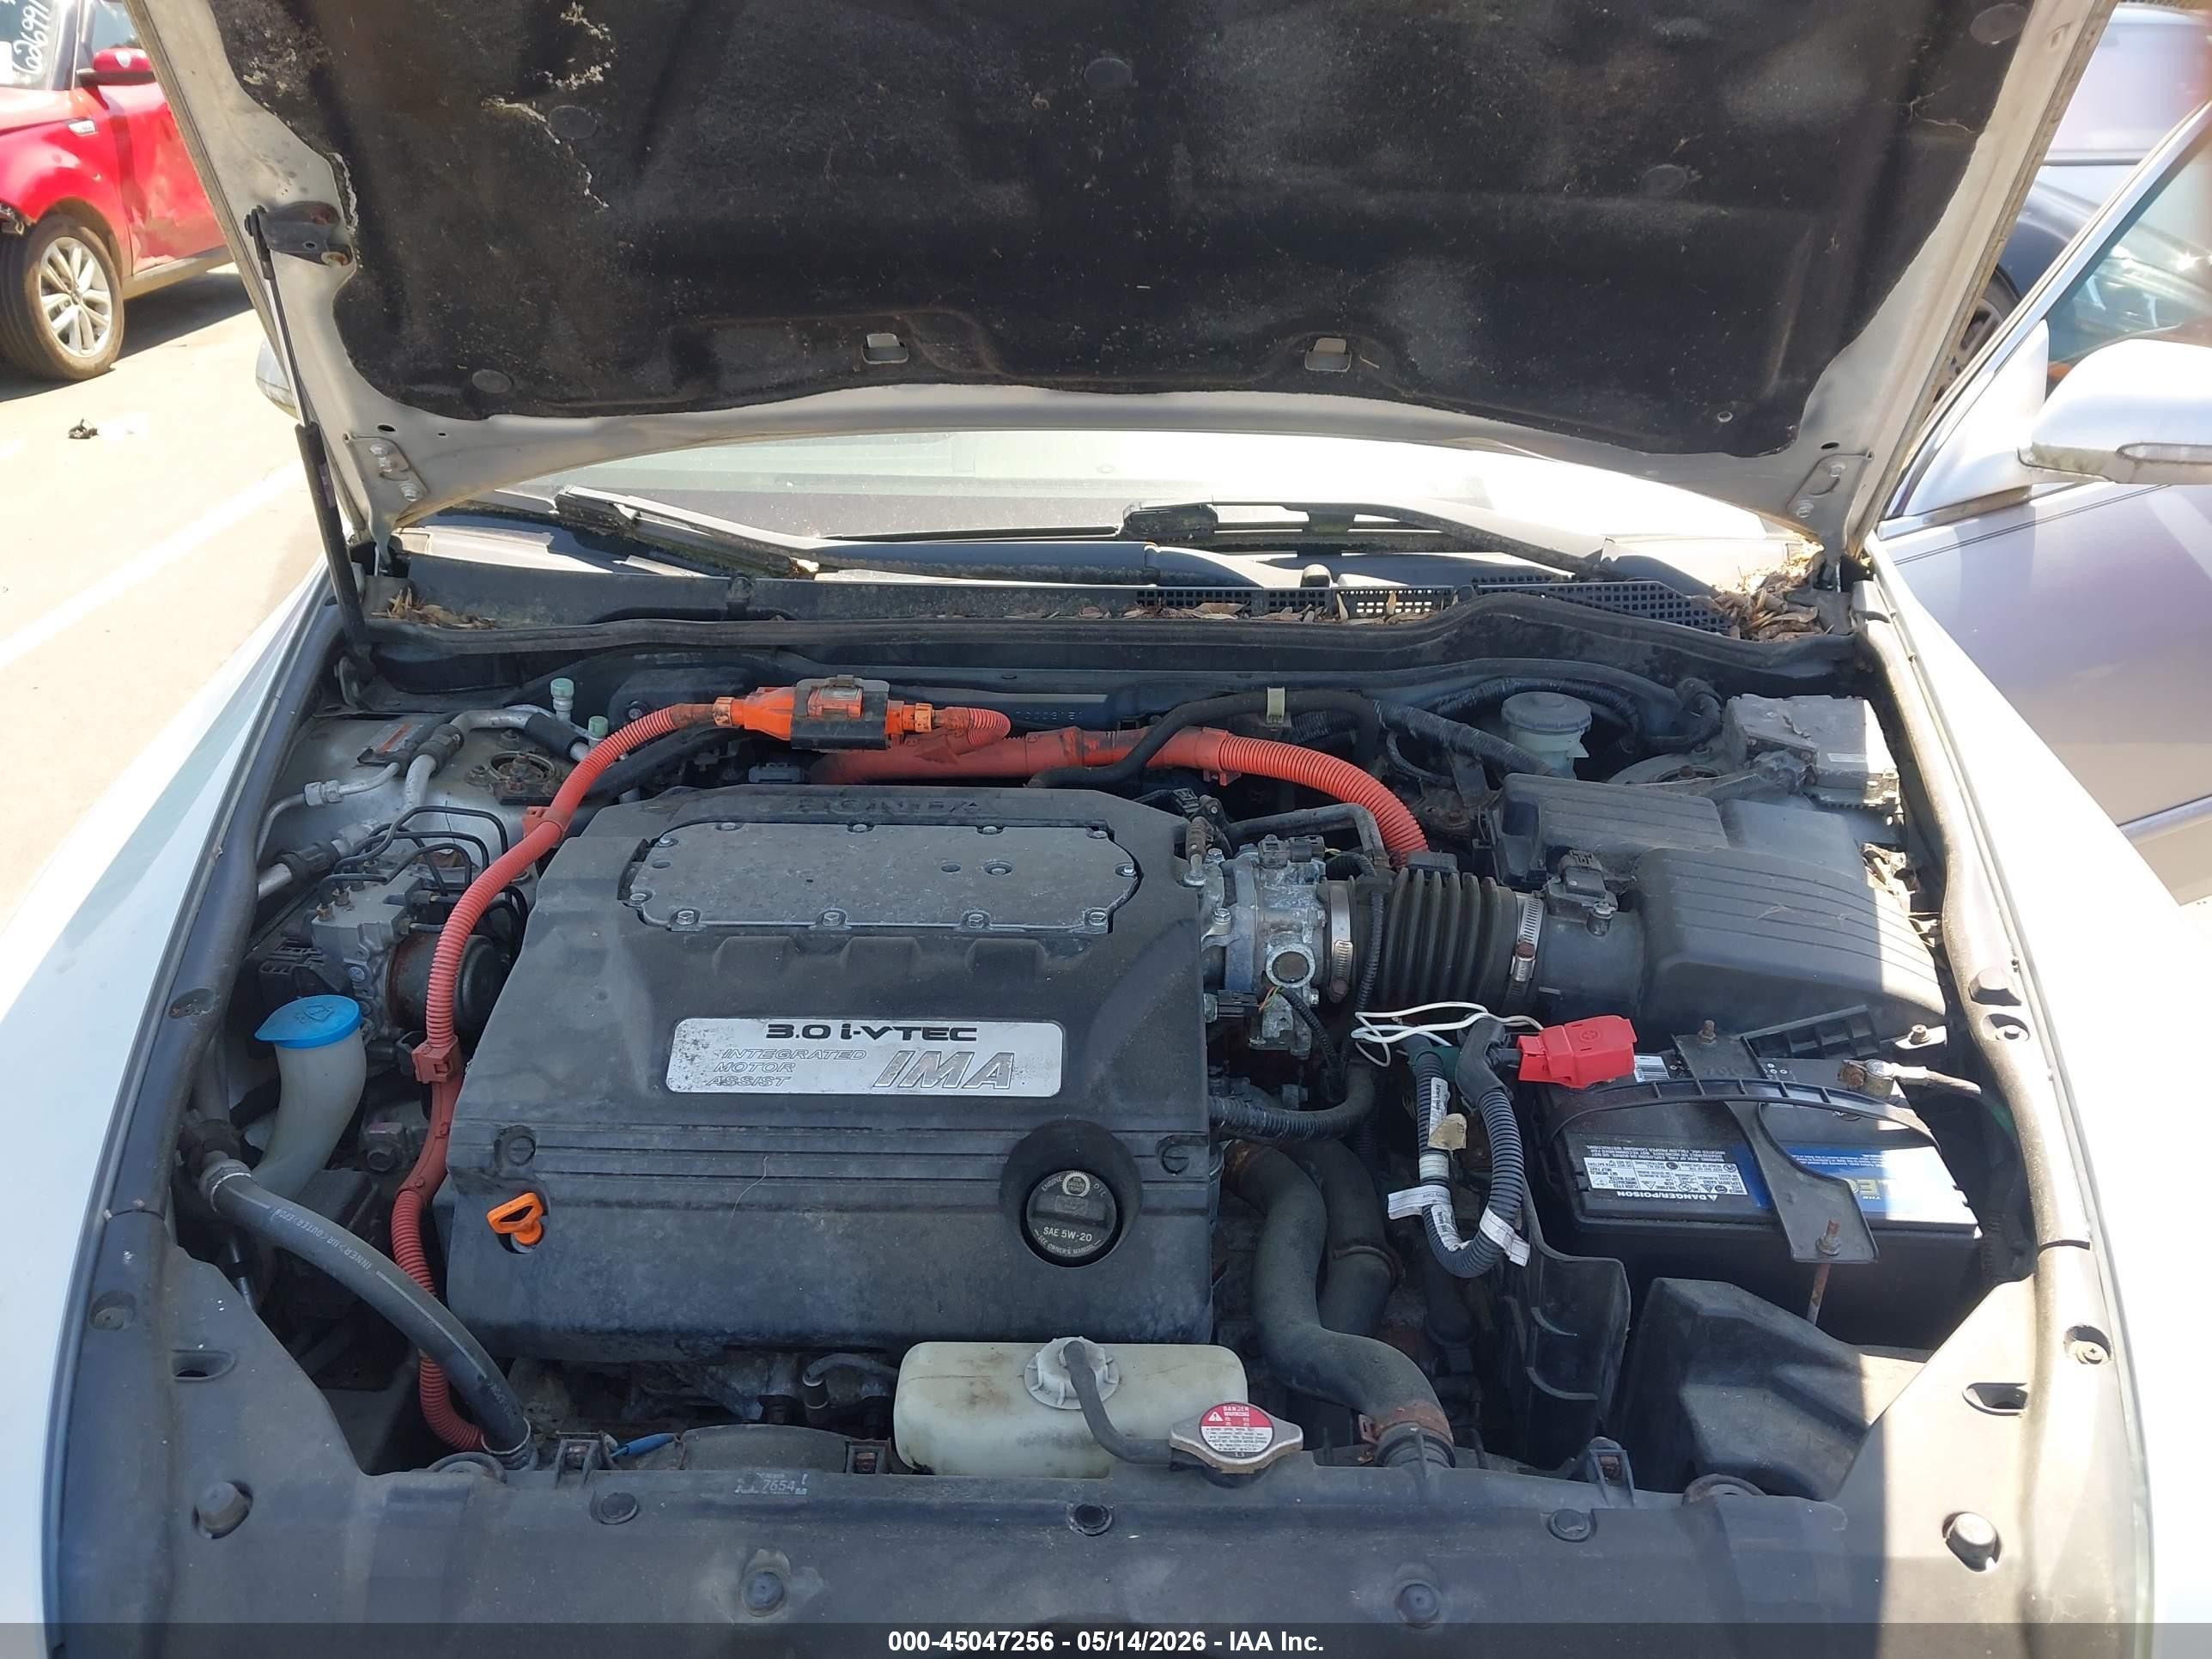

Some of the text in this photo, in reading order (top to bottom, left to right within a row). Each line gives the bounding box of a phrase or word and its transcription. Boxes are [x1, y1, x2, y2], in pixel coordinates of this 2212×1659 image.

[766, 1024, 831, 1040] 3.0
[721, 1048, 867, 1060] INTEGRATED
[713, 1061, 797, 1073] MOTOR
[872, 1049, 1016, 1090] IMA
[705, 1075, 792, 1087] ASSIST
[1617, 1189, 1708, 1200] DANGER/POISON
[1042, 1226, 1093, 1243] SAE 5W-20
